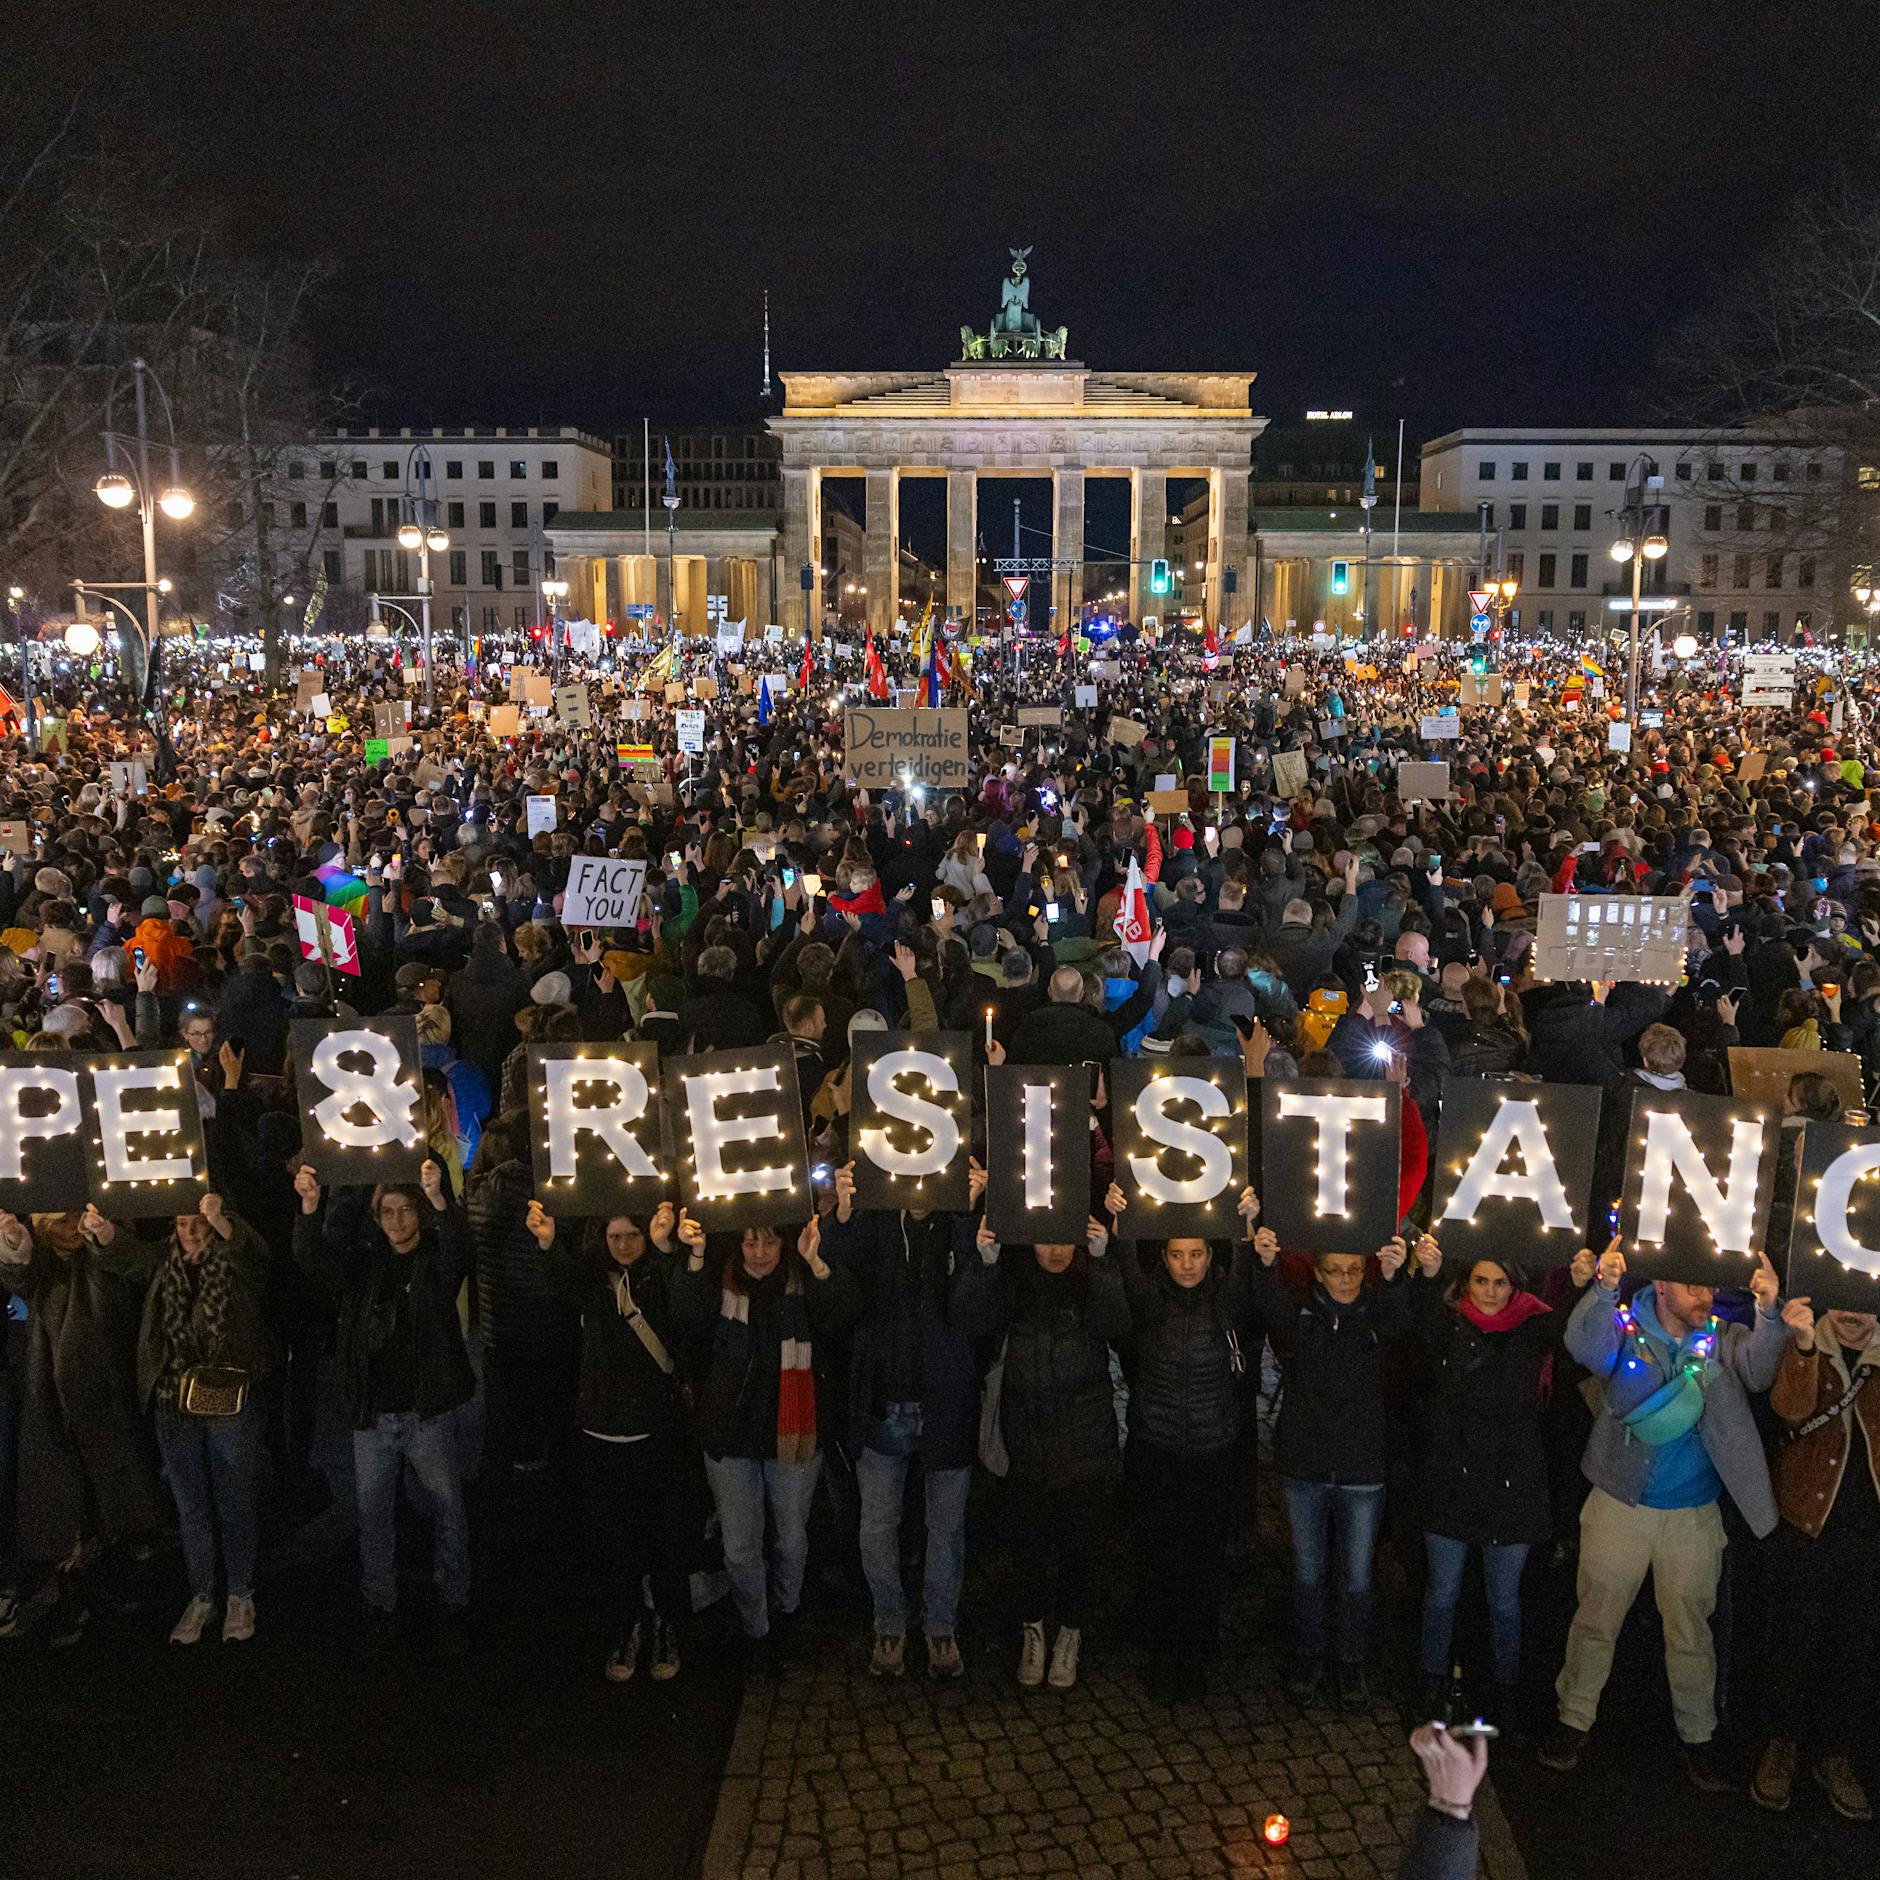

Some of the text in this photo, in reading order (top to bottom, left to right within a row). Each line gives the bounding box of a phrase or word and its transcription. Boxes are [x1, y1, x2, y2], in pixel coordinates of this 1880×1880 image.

[1306, 410, 1329, 420] HOTEL
[849, 712, 962, 750] Demokratie
[850, 752, 966, 786] verteidigen
[577, 863, 643, 895] FACT
[311, 1029, 422, 1149] &
[1799, 1414, 1830, 1436] adidas
